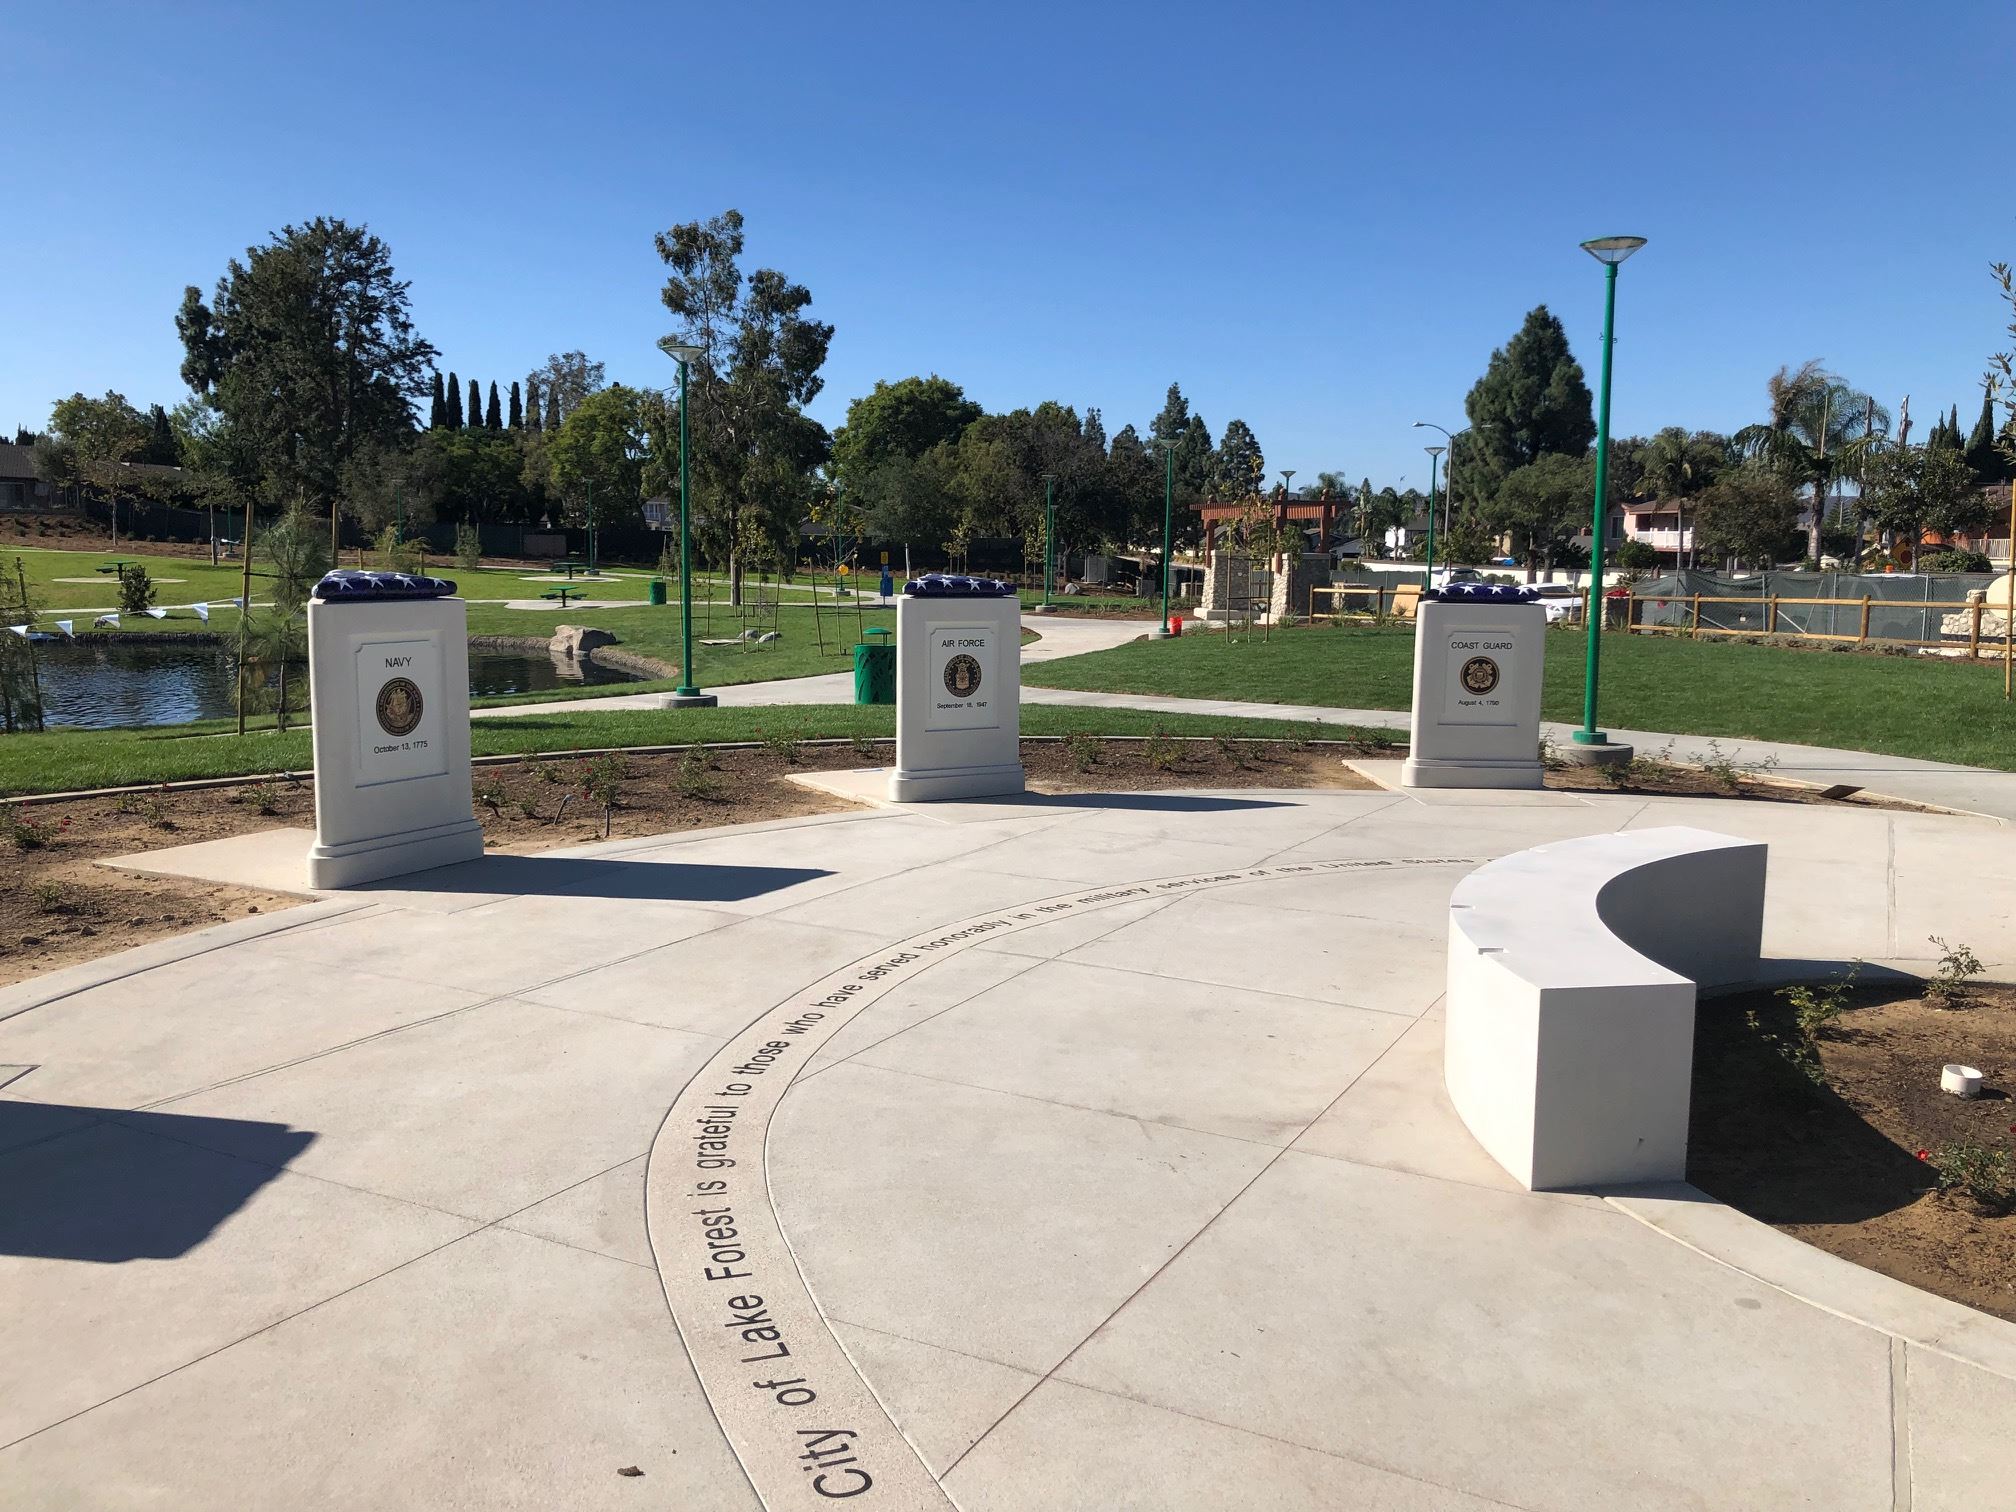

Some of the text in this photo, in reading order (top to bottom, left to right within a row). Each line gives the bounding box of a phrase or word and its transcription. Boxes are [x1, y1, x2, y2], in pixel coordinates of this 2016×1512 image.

[941, 639, 985, 648] AIR FORCE
[1450, 641, 1513, 650] COAST GUARD
[385, 657, 412, 668] NAVY
[373, 740, 428, 754] October 13, 1775
[1156, 874, 1242, 889] services
[1076, 885, 1151, 906] military
[1008, 912, 1037, 921] in
[1034, 901, 1073, 914] the
[913, 918, 1013, 952] honorably
[858, 952, 921, 981] served
[810, 983, 864, 1008] have
[781, 1012, 825, 1035] who
[731, 1040, 790, 1075] those
[714, 1081, 752, 1097] to
[692, 1104, 740, 1170] grateful
[687, 1180, 727, 1197] is
[691, 1206, 753, 1282] Forest
[724, 1294, 791, 1364] Lake
[752, 1377, 817, 1407] of
[796, 1429, 873, 1499] City
